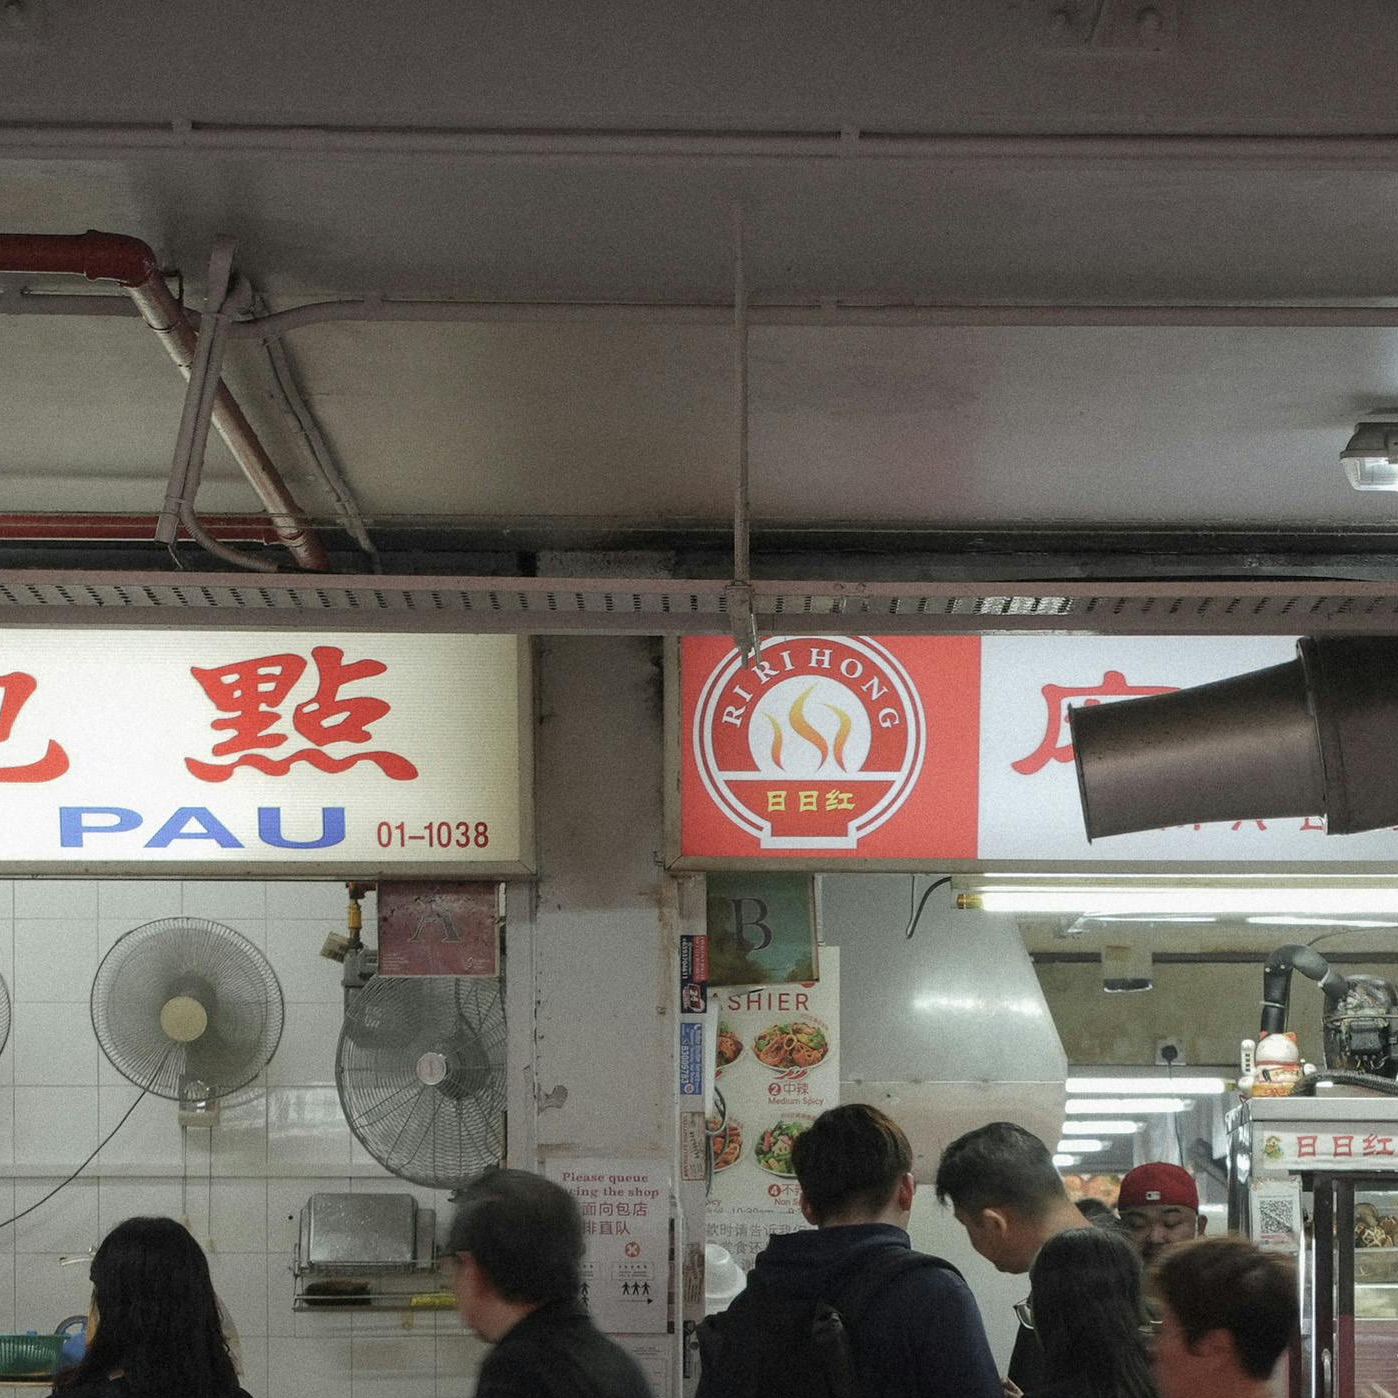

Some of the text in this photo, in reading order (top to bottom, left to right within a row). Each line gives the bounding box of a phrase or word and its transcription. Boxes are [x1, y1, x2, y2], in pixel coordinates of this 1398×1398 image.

[808, 648, 901, 729] HONG
[767, 789, 856, 812] 日日红
[58, 806, 347, 849] PAU
[377, 820, 491, 849] 01-1038
[730, 898, 773, 951] B
[712, 993, 810, 1012] SHIER
[562, 1171, 649, 1184] Please queue
[602, 1186, 624, 1197] the
[627, 1186, 660, 1200] shop
